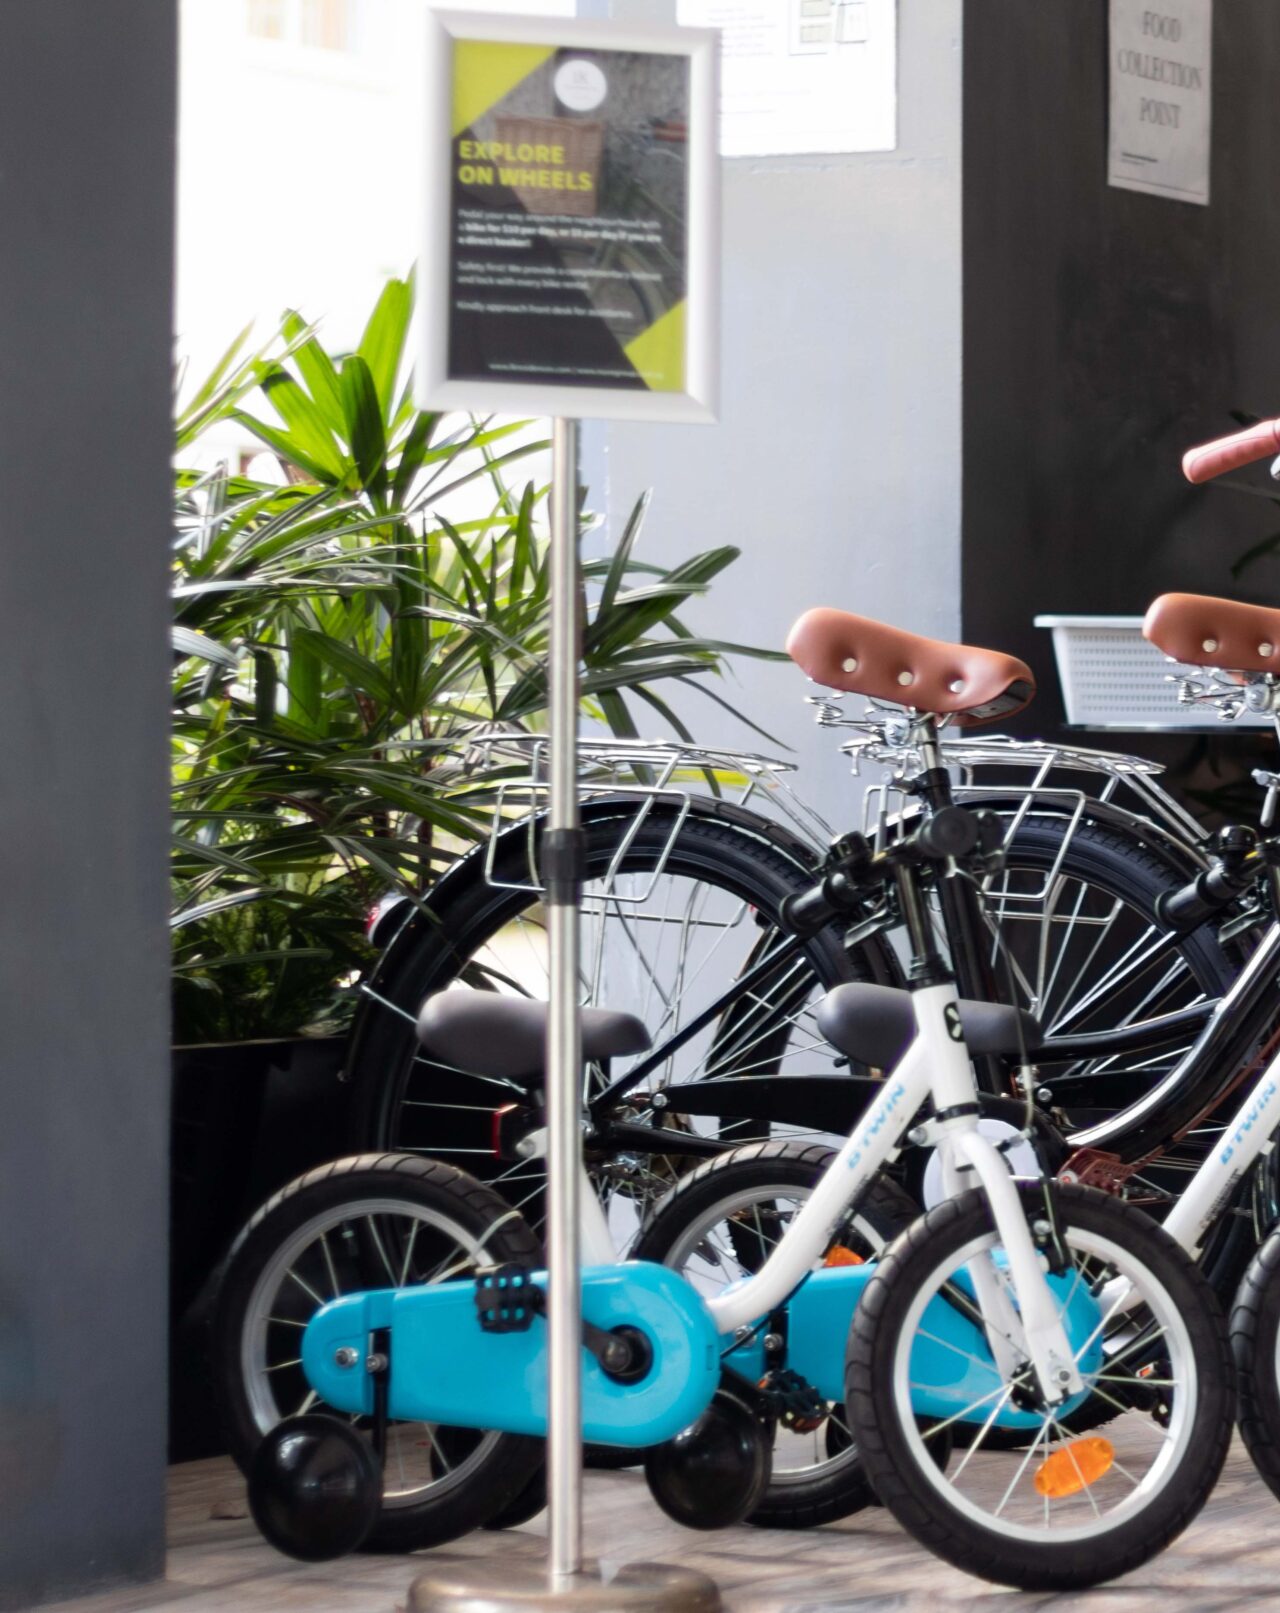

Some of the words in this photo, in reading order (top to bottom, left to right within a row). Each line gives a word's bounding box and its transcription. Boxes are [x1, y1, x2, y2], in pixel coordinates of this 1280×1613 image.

[1142, 11, 1182, 42] FOOD
[1118, 49, 1203, 91] COLLECTION
[1139, 97, 1181, 129] POINT
[459, 139, 565, 165] EXPLORE
[458, 164, 494, 185] ON
[498, 166, 593, 192] WHEELS
